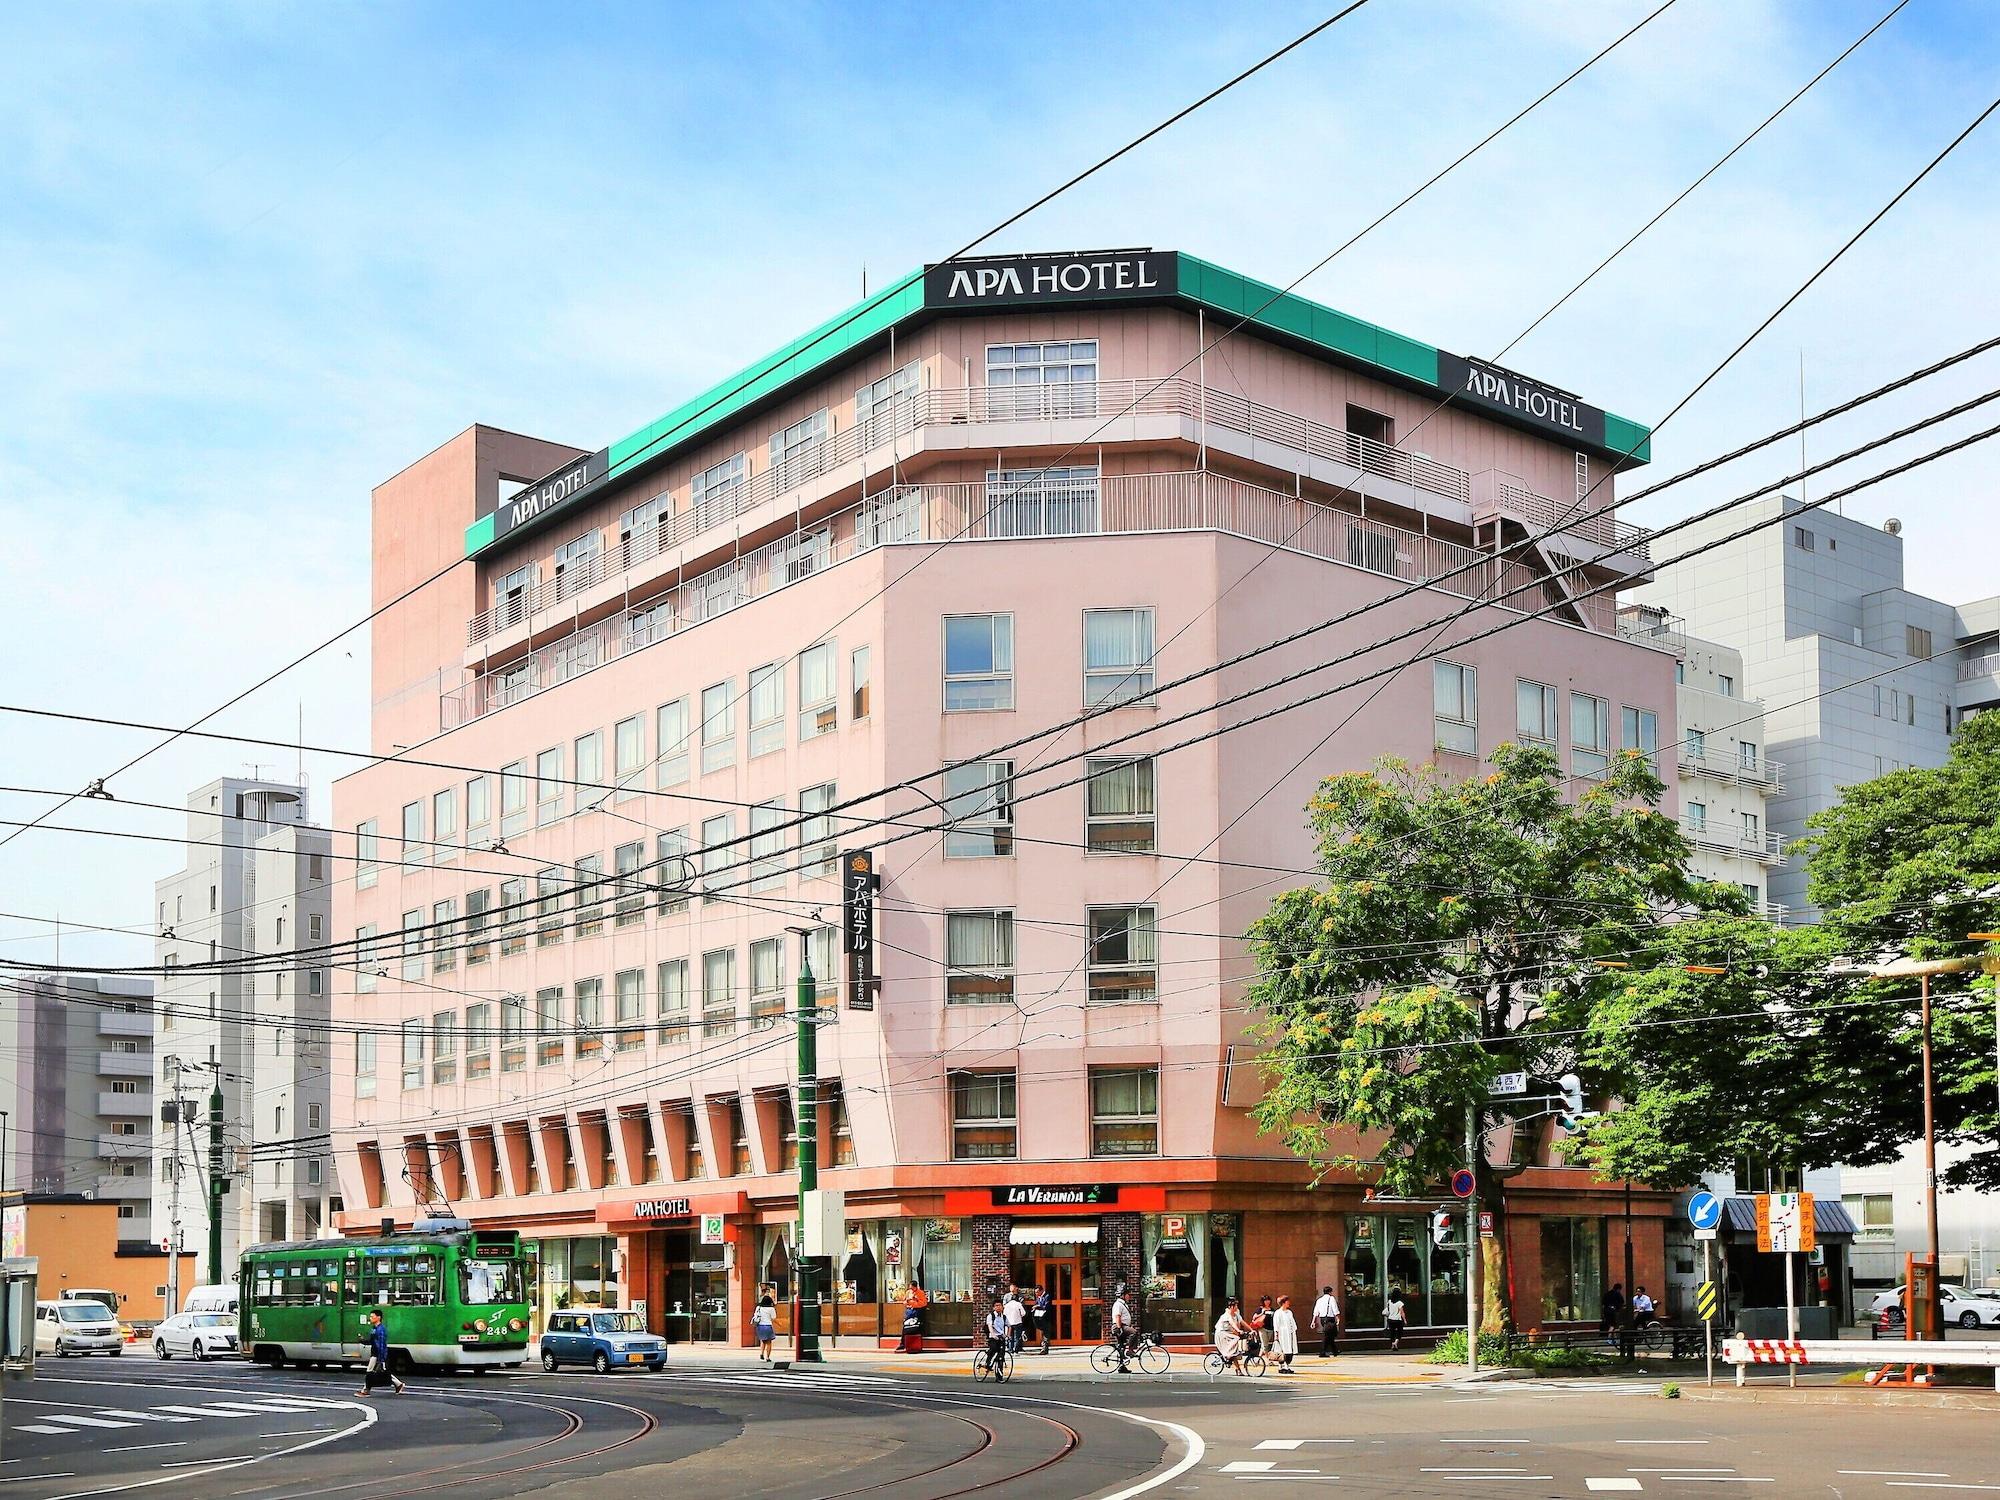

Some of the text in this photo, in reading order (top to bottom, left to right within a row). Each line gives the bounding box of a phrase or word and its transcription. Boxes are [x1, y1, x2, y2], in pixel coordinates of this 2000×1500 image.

[948, 260, 1157, 298] APA HOTEL
[1466, 367, 1584, 432] APA HOTEL
[510, 465, 591, 529] APA HOTEL
[853, 876, 868, 950] アパホテル
[633, 1198, 690, 1217] APA HOTEL
[1007, 1187, 1084, 1203] LA VERANDA
[1167, 1218, 1183, 1236] P
[1758, 1198, 1769, 1248] 右折方法
[1800, 1197, 1812, 1248] 内まわり
[486, 1326, 508, 1336] 248
